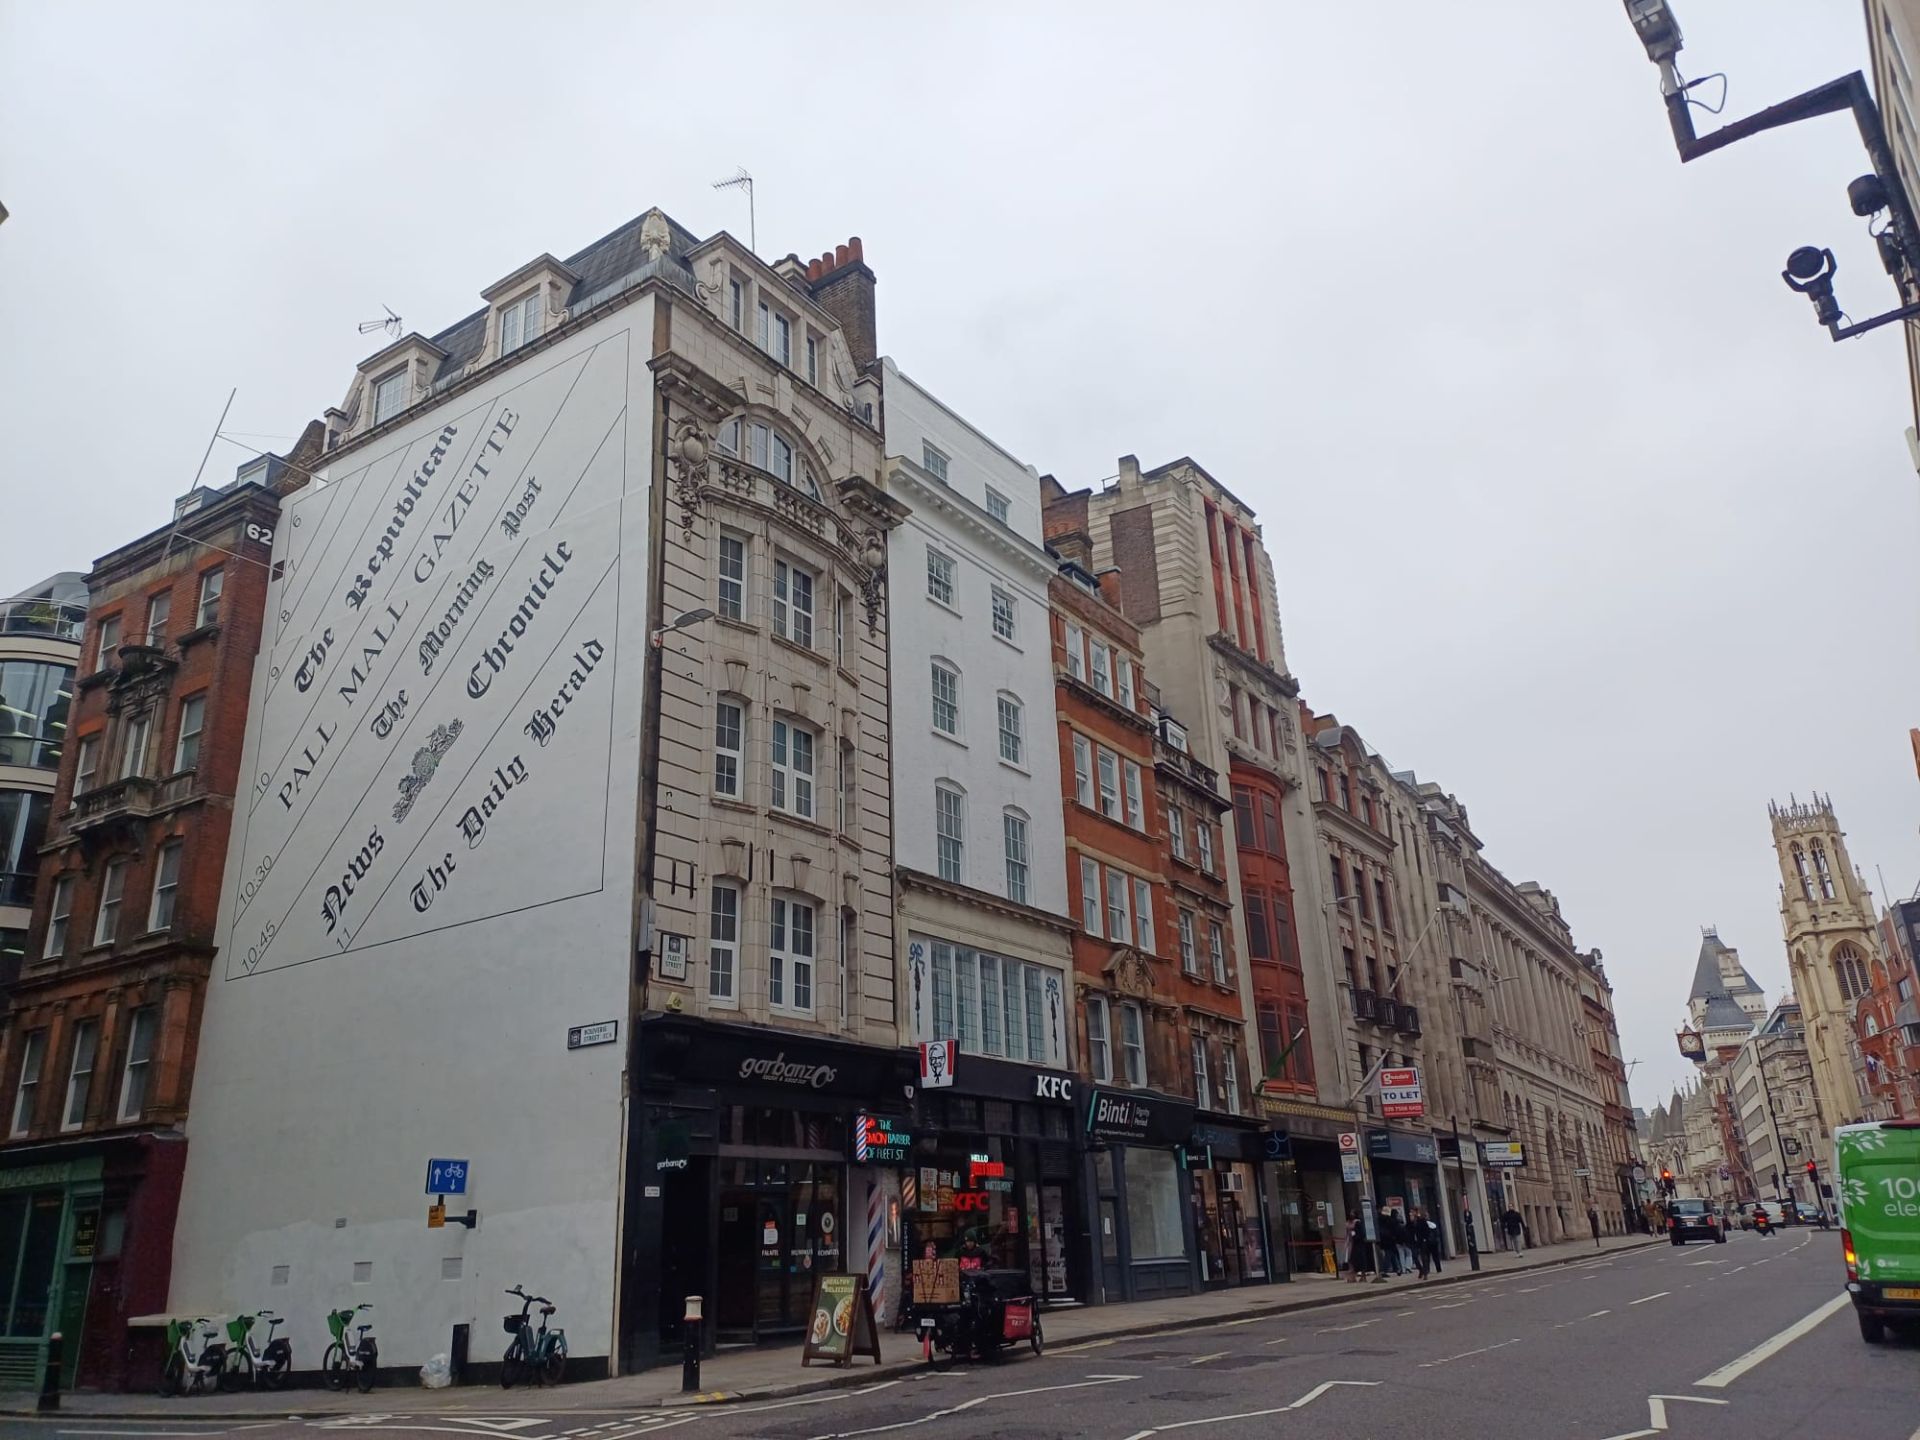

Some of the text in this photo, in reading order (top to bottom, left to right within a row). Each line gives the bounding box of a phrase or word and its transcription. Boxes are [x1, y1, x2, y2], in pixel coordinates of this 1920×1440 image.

[247, 523, 273, 546] 62
[294, 425, 458, 694] The Republican
[279, 407, 519, 811] PALL MALL GAZETTE
[280, 608, 290, 623] 8
[371, 476, 543, 741] The Morning Post
[270, 666, 280, 681] 9
[320, 541, 574, 935] News Chronicle
[254, 771, 271, 796] 10
[409, 637, 605, 914] The Daily Herald
[239, 854, 273, 906] 10:30
[240, 920, 276, 973] 10:45
[335, 931, 351, 952] 11
[1036, 1075, 1072, 1100] KFC
[1383, 1090, 1419, 1100] TO LET
[878, 1119, 892, 1131] THE
[888, 1133, 911, 1147] BARBER
[876, 1147, 896, 1160] FLEET
[970, 1153, 989, 1163] HELLO
[1879, 1177, 1920, 1199] 10
[953, 1192, 989, 1212] KFC
